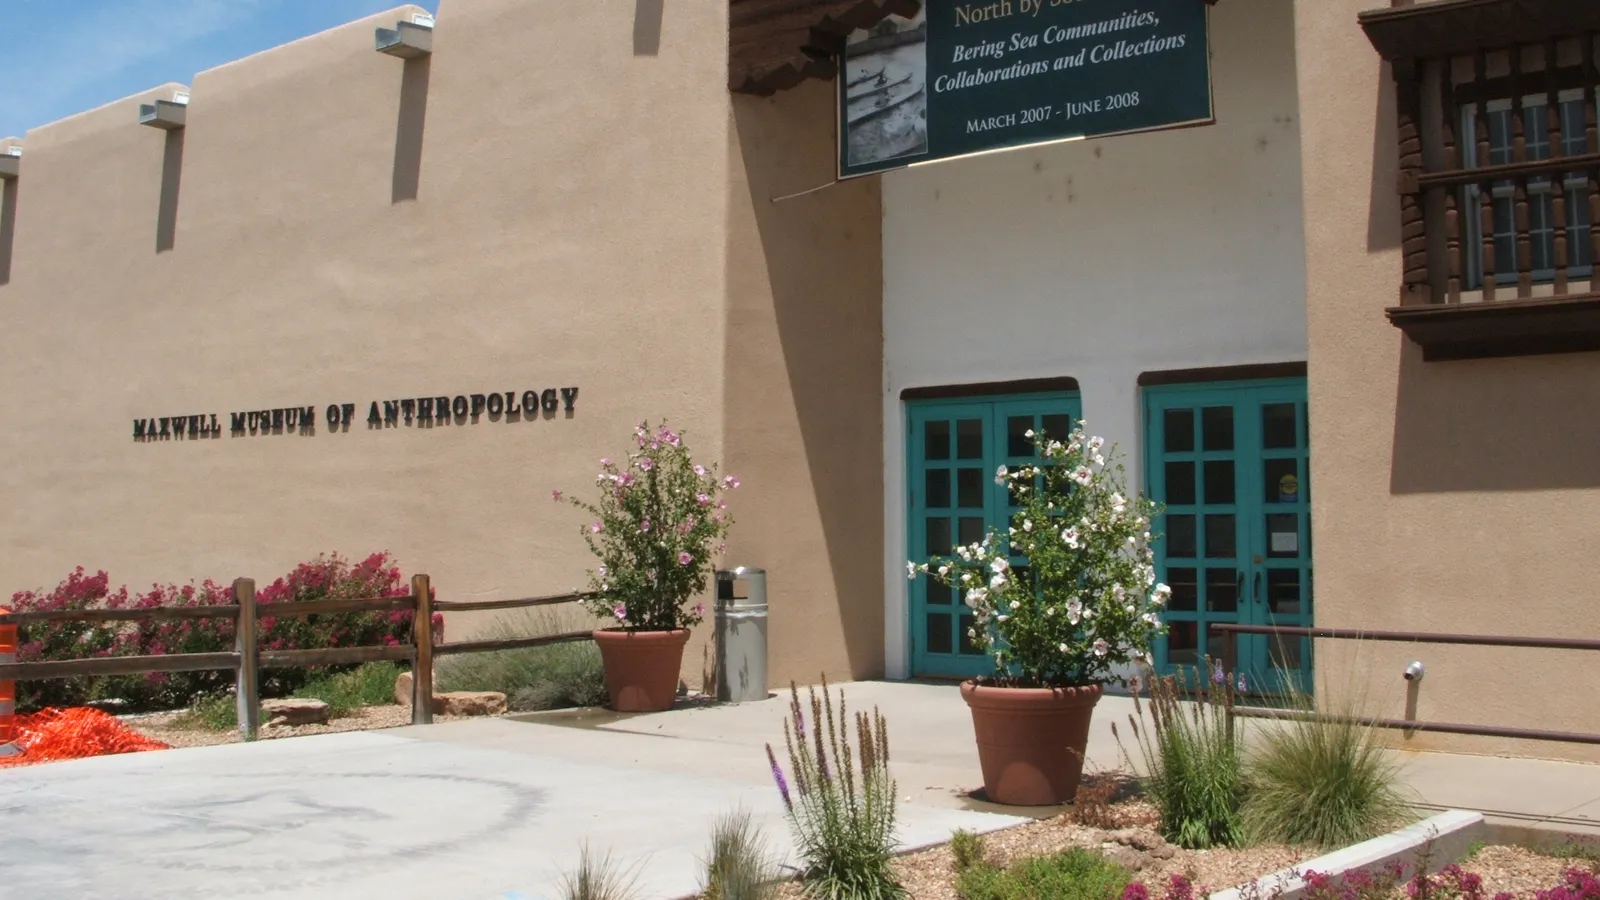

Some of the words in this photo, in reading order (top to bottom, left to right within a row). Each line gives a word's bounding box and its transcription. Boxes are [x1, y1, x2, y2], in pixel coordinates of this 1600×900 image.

[952, 40, 1005, 64] Bering
[1008, 32, 1039, 52] Sea
[1043, 8, 1160, 45] Communities,
[954, 0, 1013, 28] North
[1020, 0, 1042, 18] by
[934, 58, 1050, 94] Collaborations
[1053, 48, 1086, 72] and
[1089, 32, 1187, 64] Collections
[966, 114, 1016, 133] MARCH
[1020, 105, 1053, 126] 2007
[1065, 98, 1102, 119] JUNE
[1105, 91, 1141, 111] 2008
[133, 413, 221, 438] MAXWELL
[230, 406, 316, 432] MUSEUM
[326, 403, 355, 428] OF
[367, 387, 579, 424] ANTHROPOLOGY
